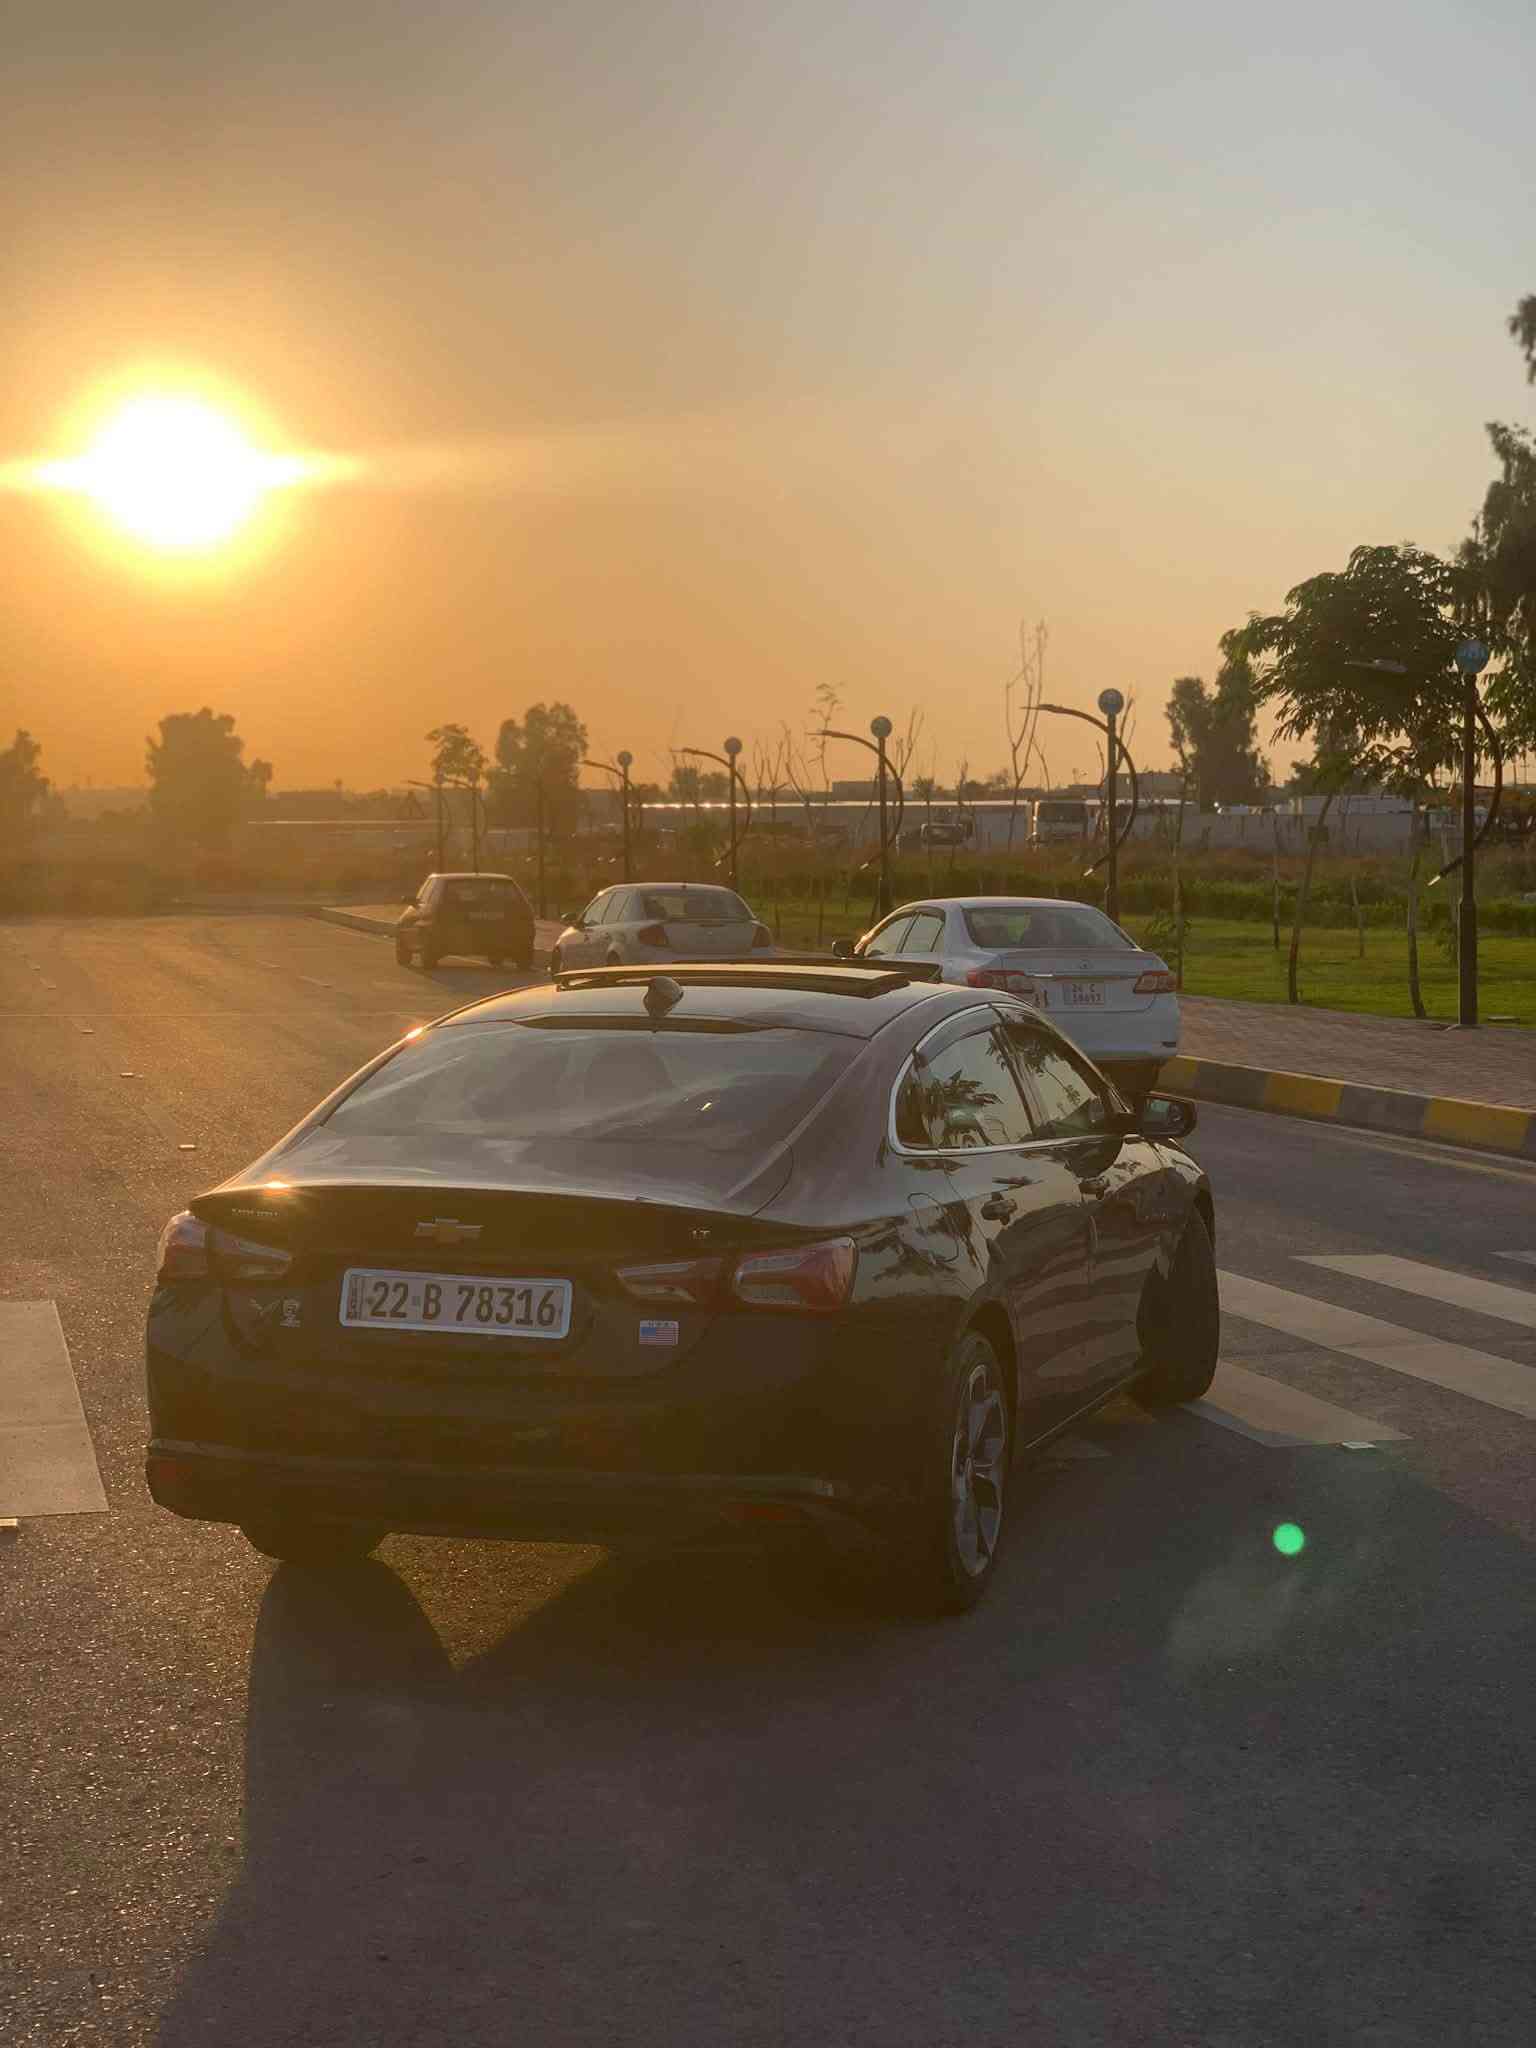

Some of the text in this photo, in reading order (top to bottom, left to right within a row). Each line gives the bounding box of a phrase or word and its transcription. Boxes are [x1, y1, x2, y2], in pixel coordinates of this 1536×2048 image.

[369, 1281, 409, 1319] 22
[422, 1283, 442, 1320] B
[455, 1285, 556, 1326] 78316
